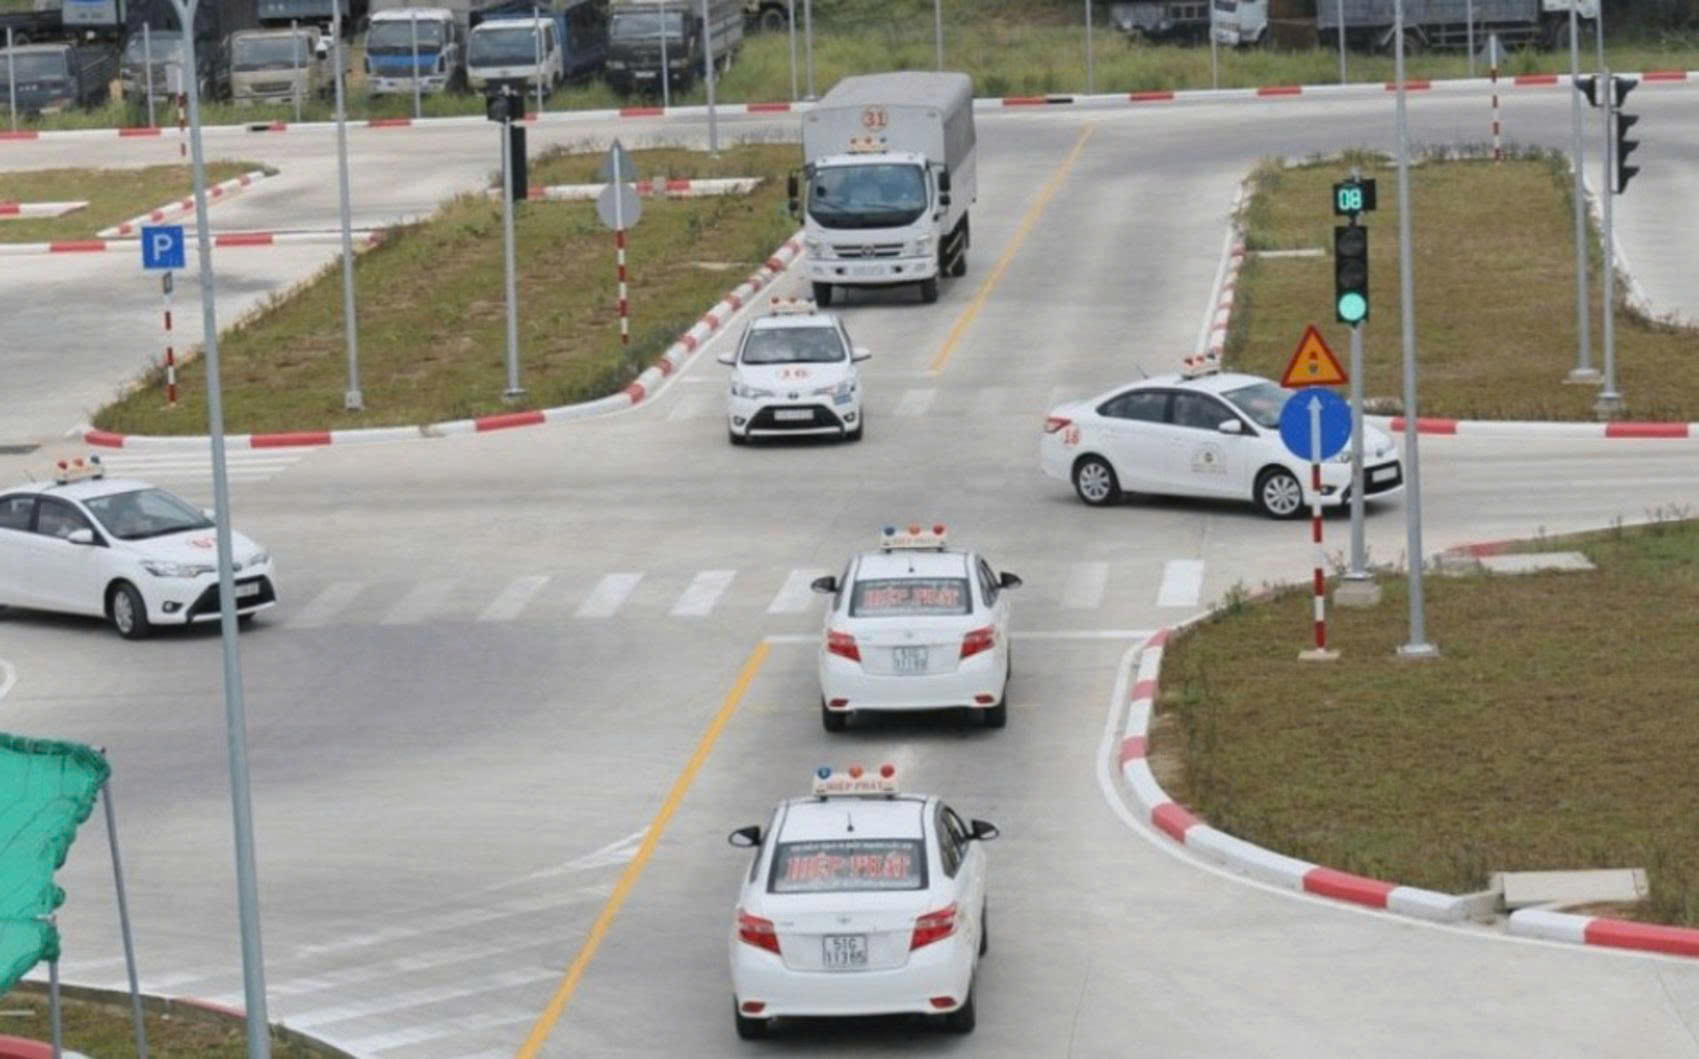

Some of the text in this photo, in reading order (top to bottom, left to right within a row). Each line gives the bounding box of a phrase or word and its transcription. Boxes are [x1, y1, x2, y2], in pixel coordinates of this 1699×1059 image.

[863, 111, 887, 127] 31
[1338, 188, 1363, 210] 08
[153, 233, 173, 260] P
